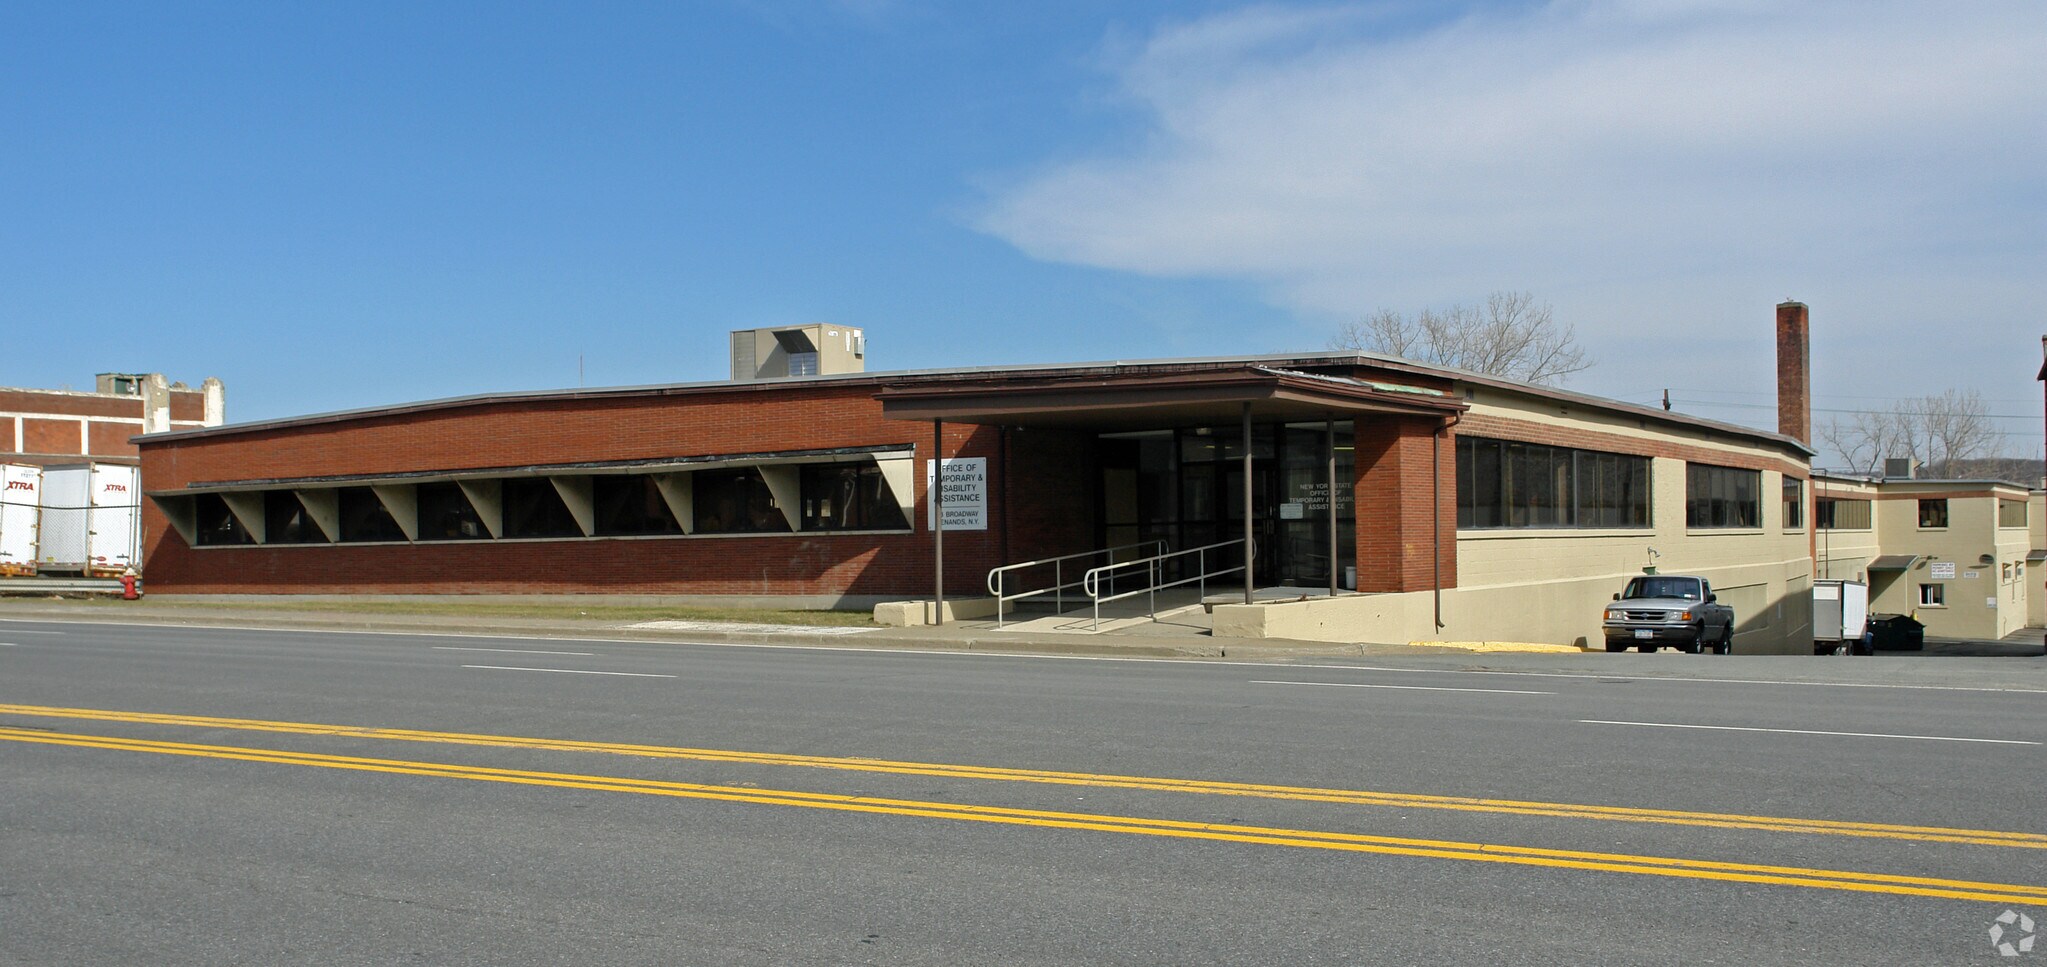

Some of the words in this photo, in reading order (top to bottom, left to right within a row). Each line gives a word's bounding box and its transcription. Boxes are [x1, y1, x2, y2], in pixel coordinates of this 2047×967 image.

[939, 464, 963, 472] FFICE
[966, 463, 976, 472] OF
[930, 474, 976, 482] TMPORARY
[978, 474, 983, 482] &
[4, 480, 34, 490] XTRA
[934, 494, 980, 502] SSISTANCE
